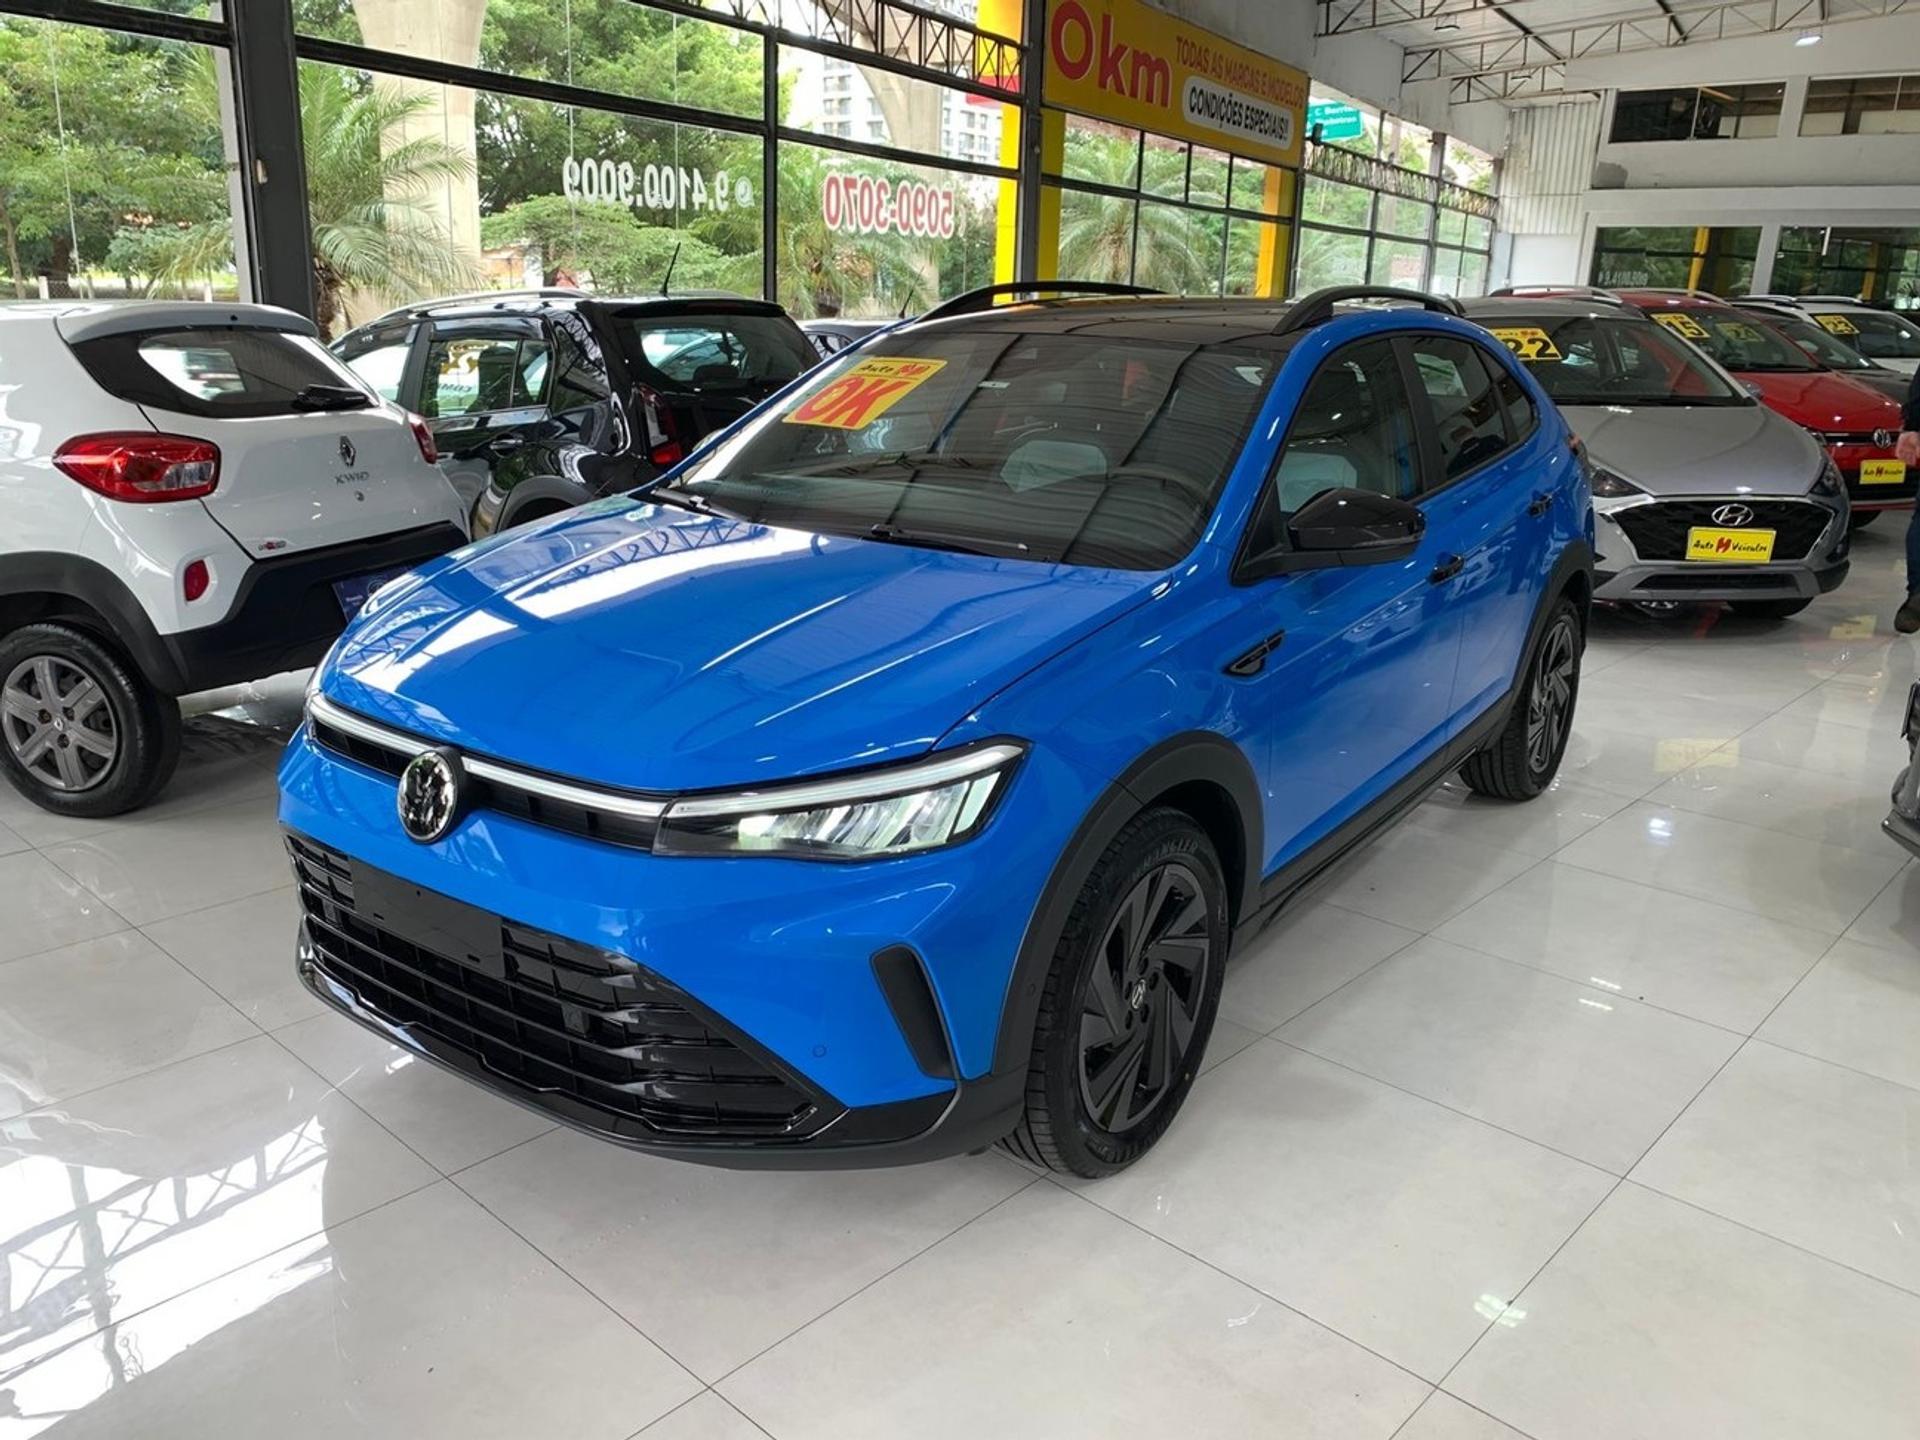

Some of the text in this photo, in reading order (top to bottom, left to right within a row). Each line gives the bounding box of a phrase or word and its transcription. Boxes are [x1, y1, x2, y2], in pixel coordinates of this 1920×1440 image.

[1176, 35, 1210, 74] TODAS
[1211, 51, 1223, 80] AS
[1224, 57, 1261, 93] MARCAS
[1268, 76, 1305, 109] MODELOS
[1189, 86, 1243, 128] CONDIÇÕES
[1693, 540, 1714, 550] Auto
